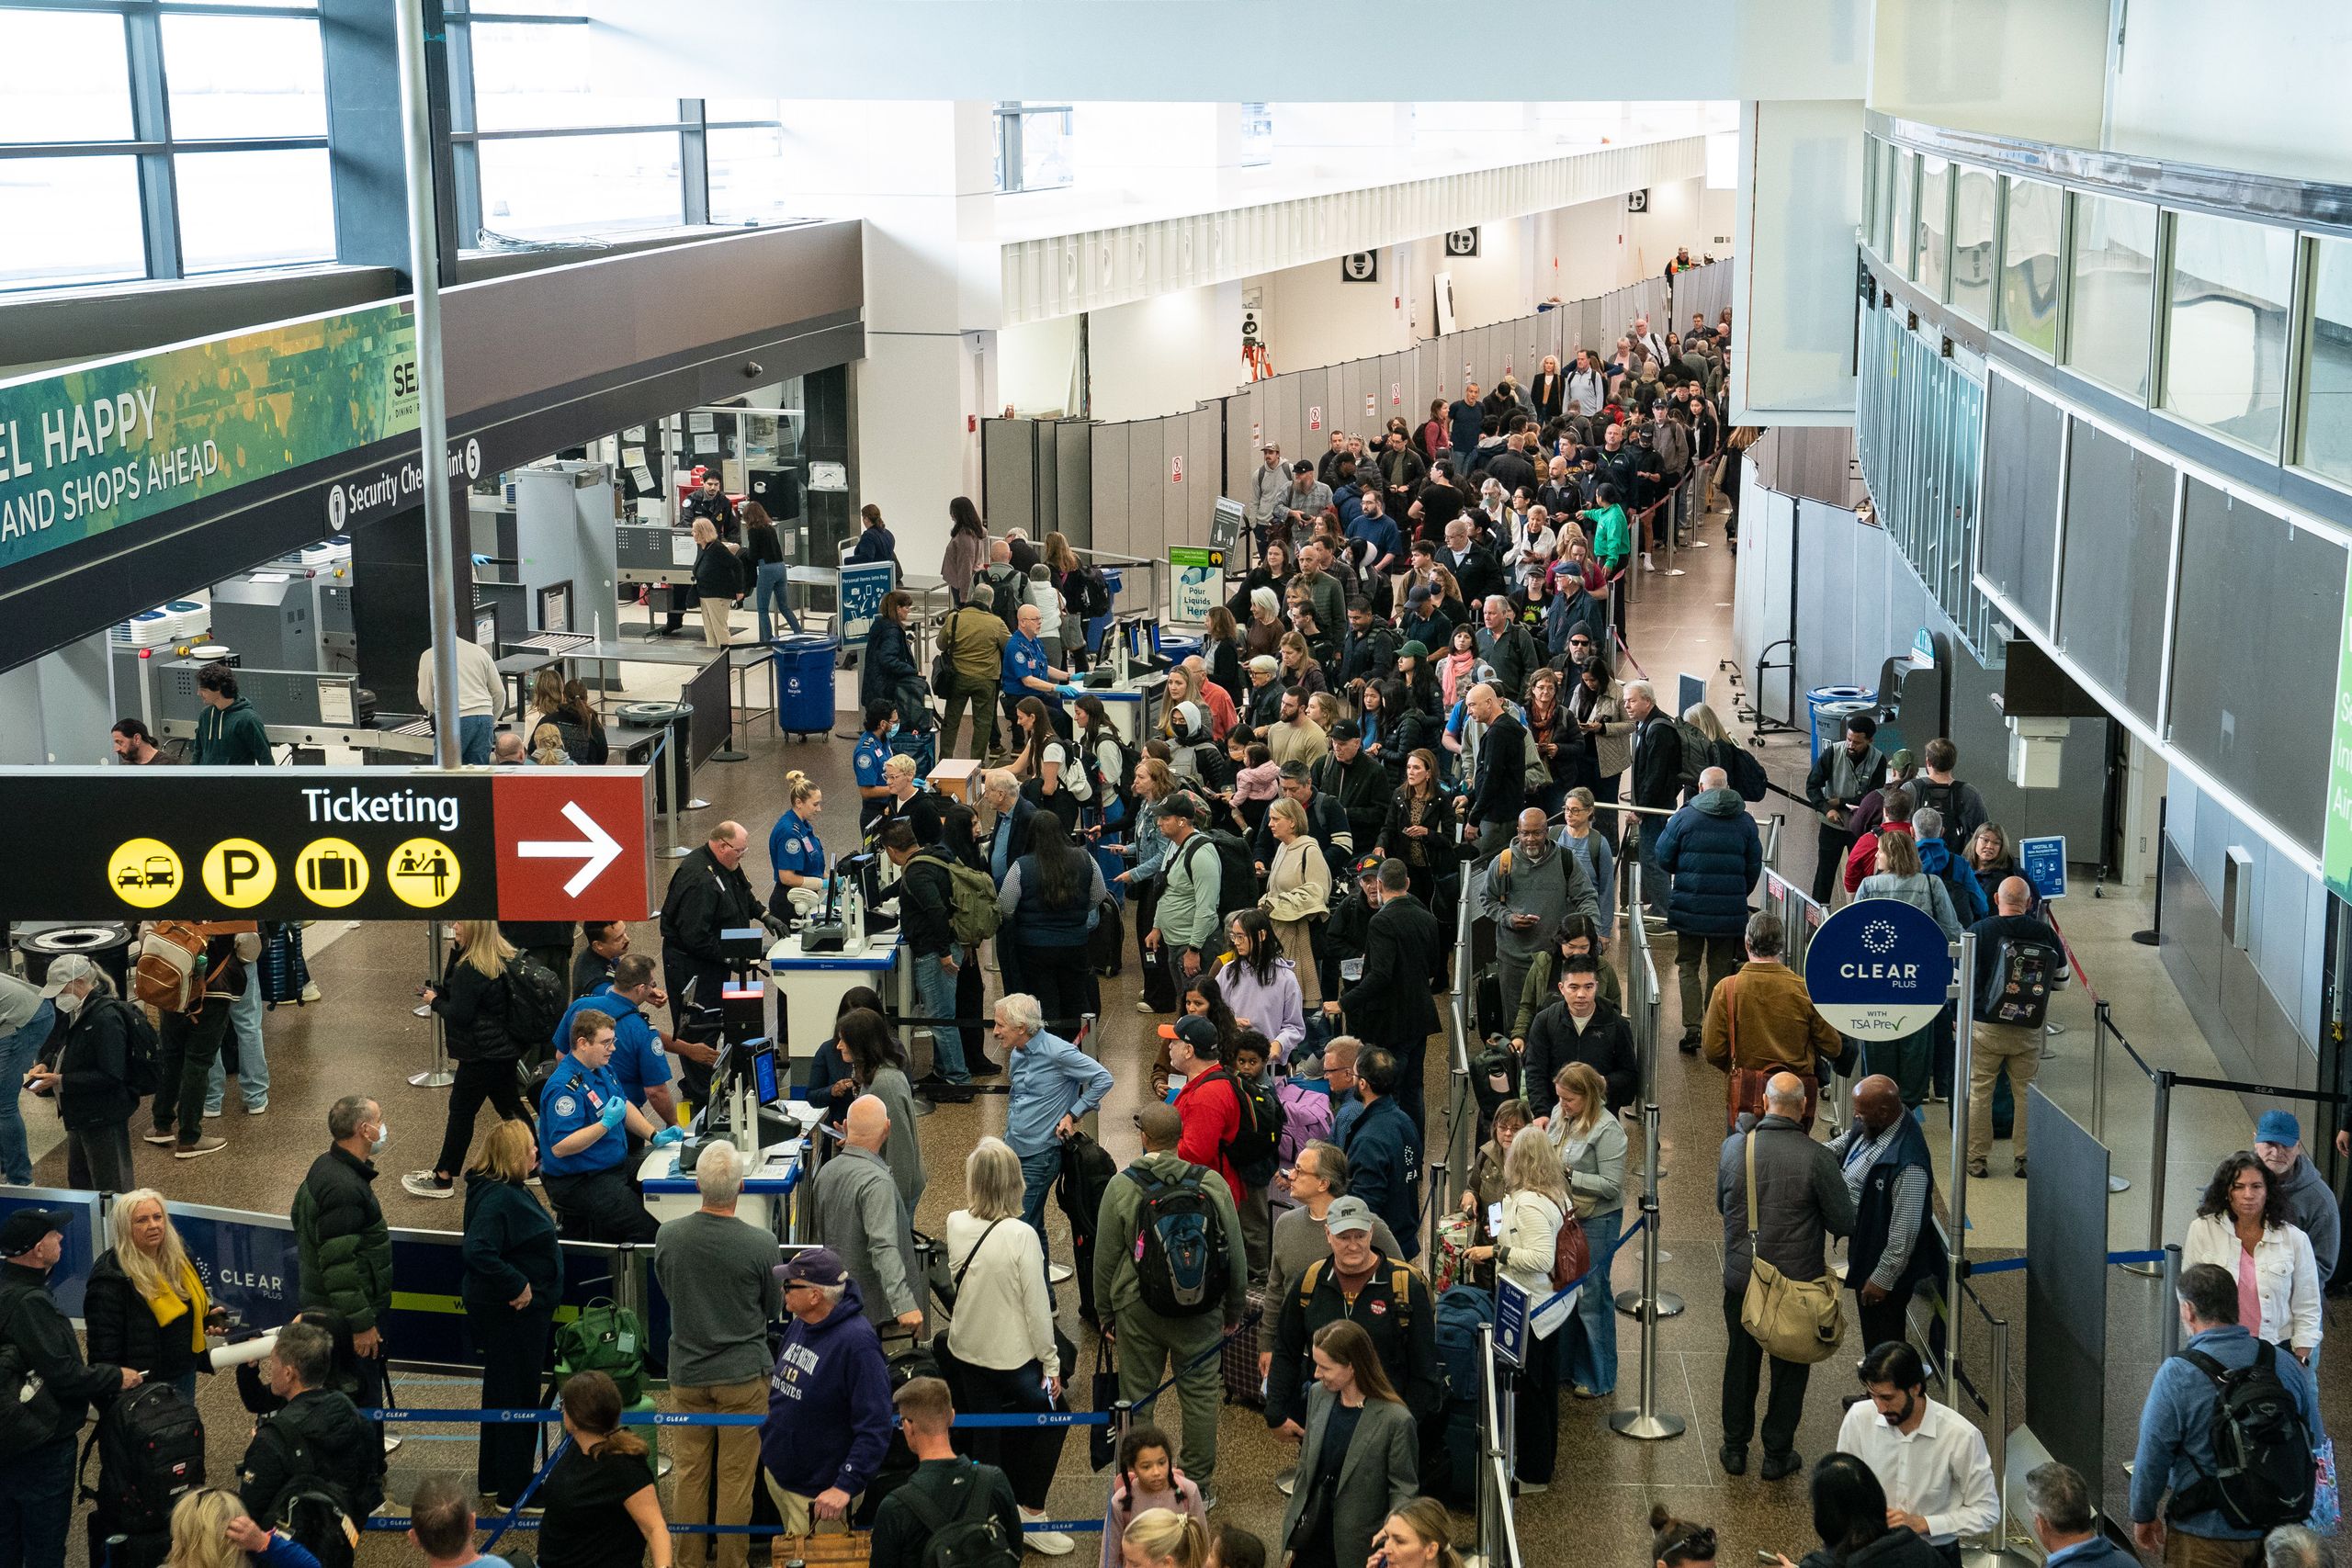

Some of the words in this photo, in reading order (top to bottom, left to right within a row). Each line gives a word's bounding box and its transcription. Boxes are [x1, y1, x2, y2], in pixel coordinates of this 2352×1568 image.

[394, 362, 420, 398] SE
[395, 405, 413, 419] DINING
[41, 386, 157, 468] HAPPY
[348, 472, 398, 514] Security
[401, 448, 464, 495] Cheint
[470, 446, 477, 472] 5
[1, 489, 55, 543] AND
[62, 462, 141, 521] SHOPS
[147, 439, 219, 495] AHEAD
[1189, 587, 1205, 595] Pour
[1183, 596, 1211, 605] Liquids
[1187, 606, 1208, 616] Here
[301, 786, 459, 832] Ticketing
[223, 850, 260, 896] P
[1840, 964, 1917, 978] CLEAR
[1892, 980, 1917, 988] PLUS
[1850, 1019, 1871, 1030] TSA
[1873, 1019, 1892, 1030] Pre
[2255, 1086, 2275, 1095] SEA
[220, 1269, 282, 1292] CLEAR
[263, 1290, 283, 1301] PLUS
[386, 1411, 409, 1419] CLEAR
[666, 1415, 689, 1423] CLEAR
[1049, 1415, 1071, 1423] CLEAR
